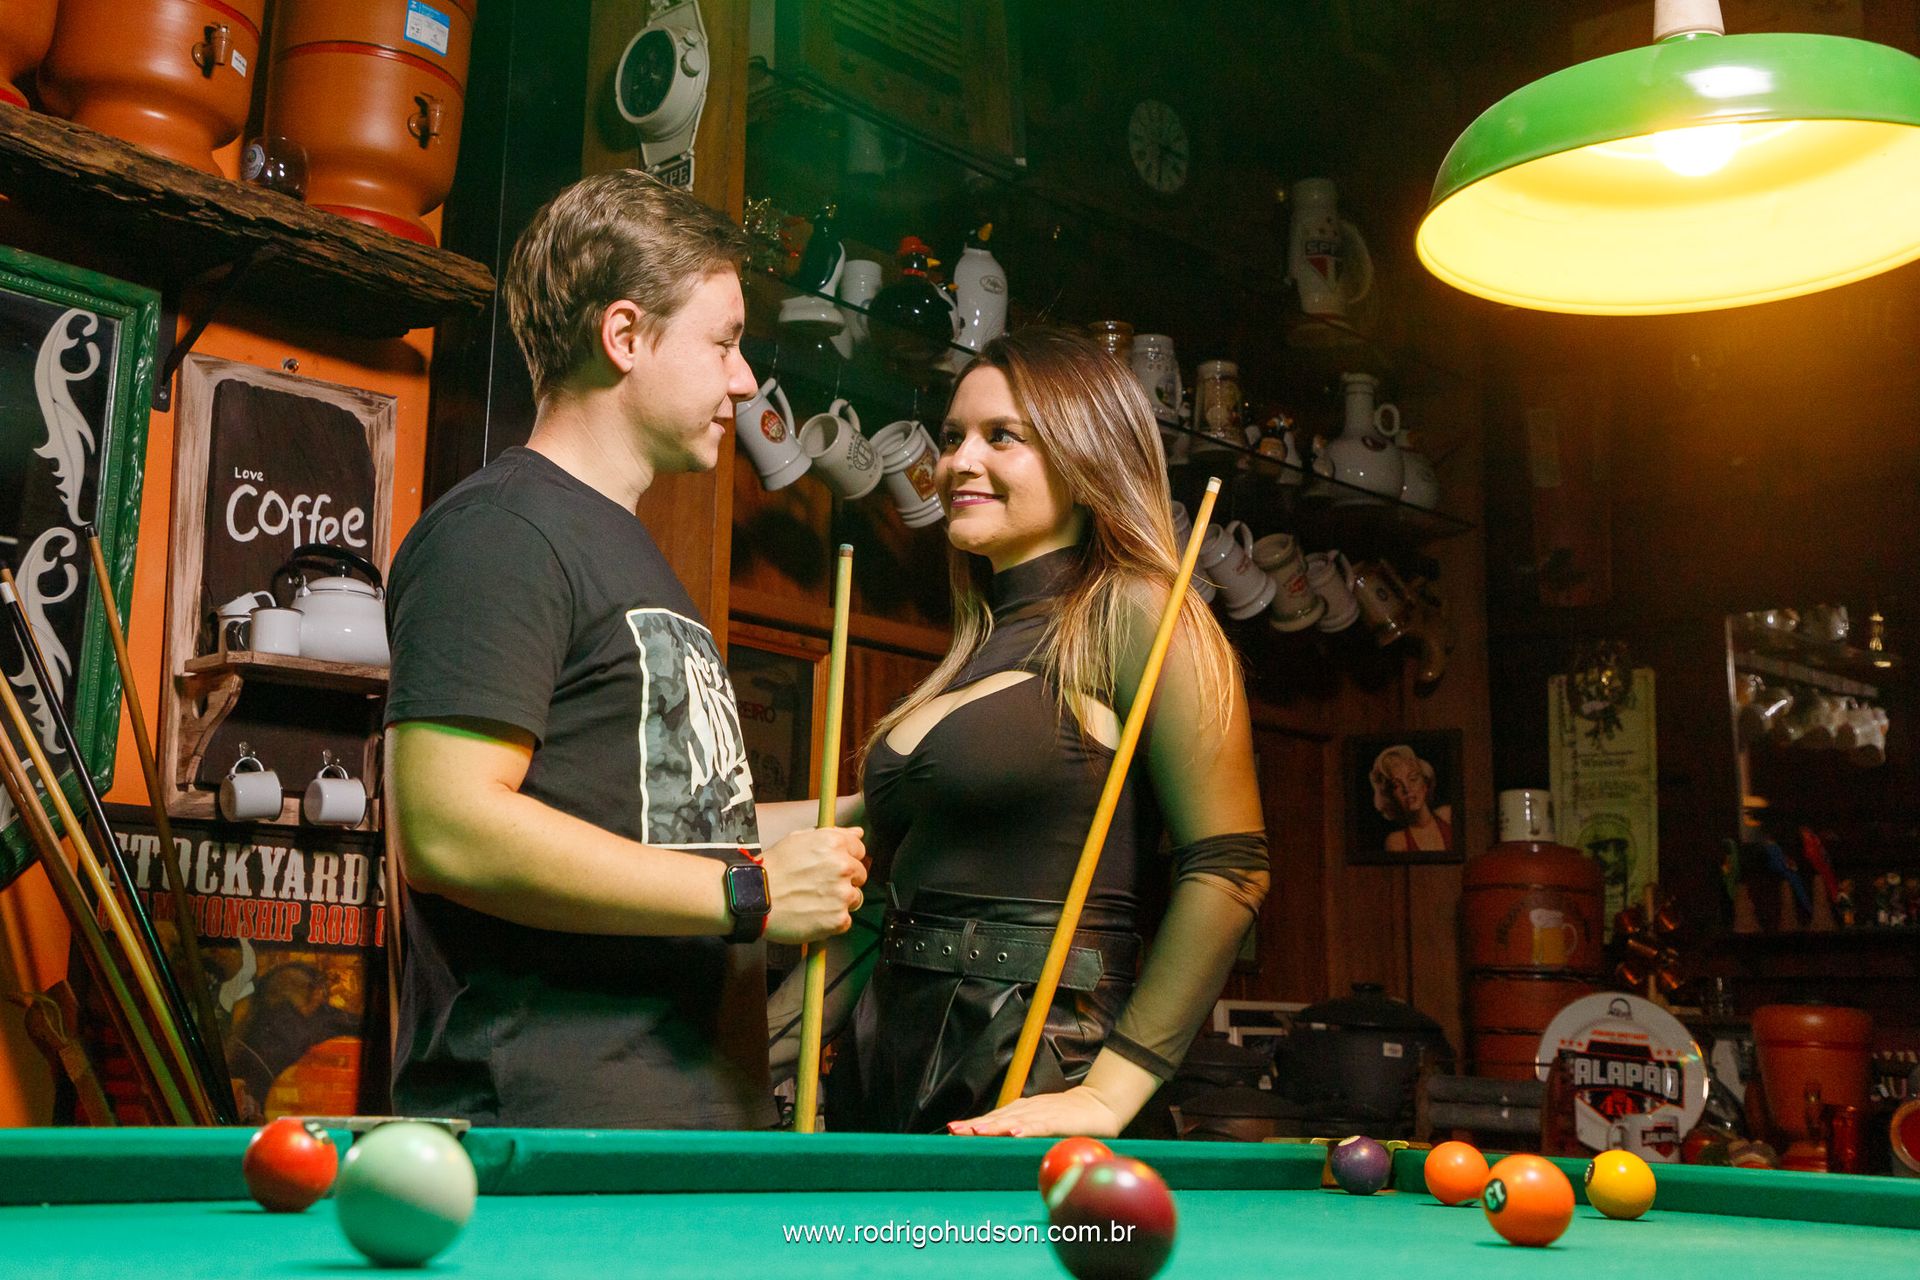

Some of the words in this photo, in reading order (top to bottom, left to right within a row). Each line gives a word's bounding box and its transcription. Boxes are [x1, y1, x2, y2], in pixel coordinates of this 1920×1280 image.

[234, 466, 264, 482] Love
[226, 484, 367, 550] Coffee
[1567, 1056, 1680, 1101] ALAPÃO
